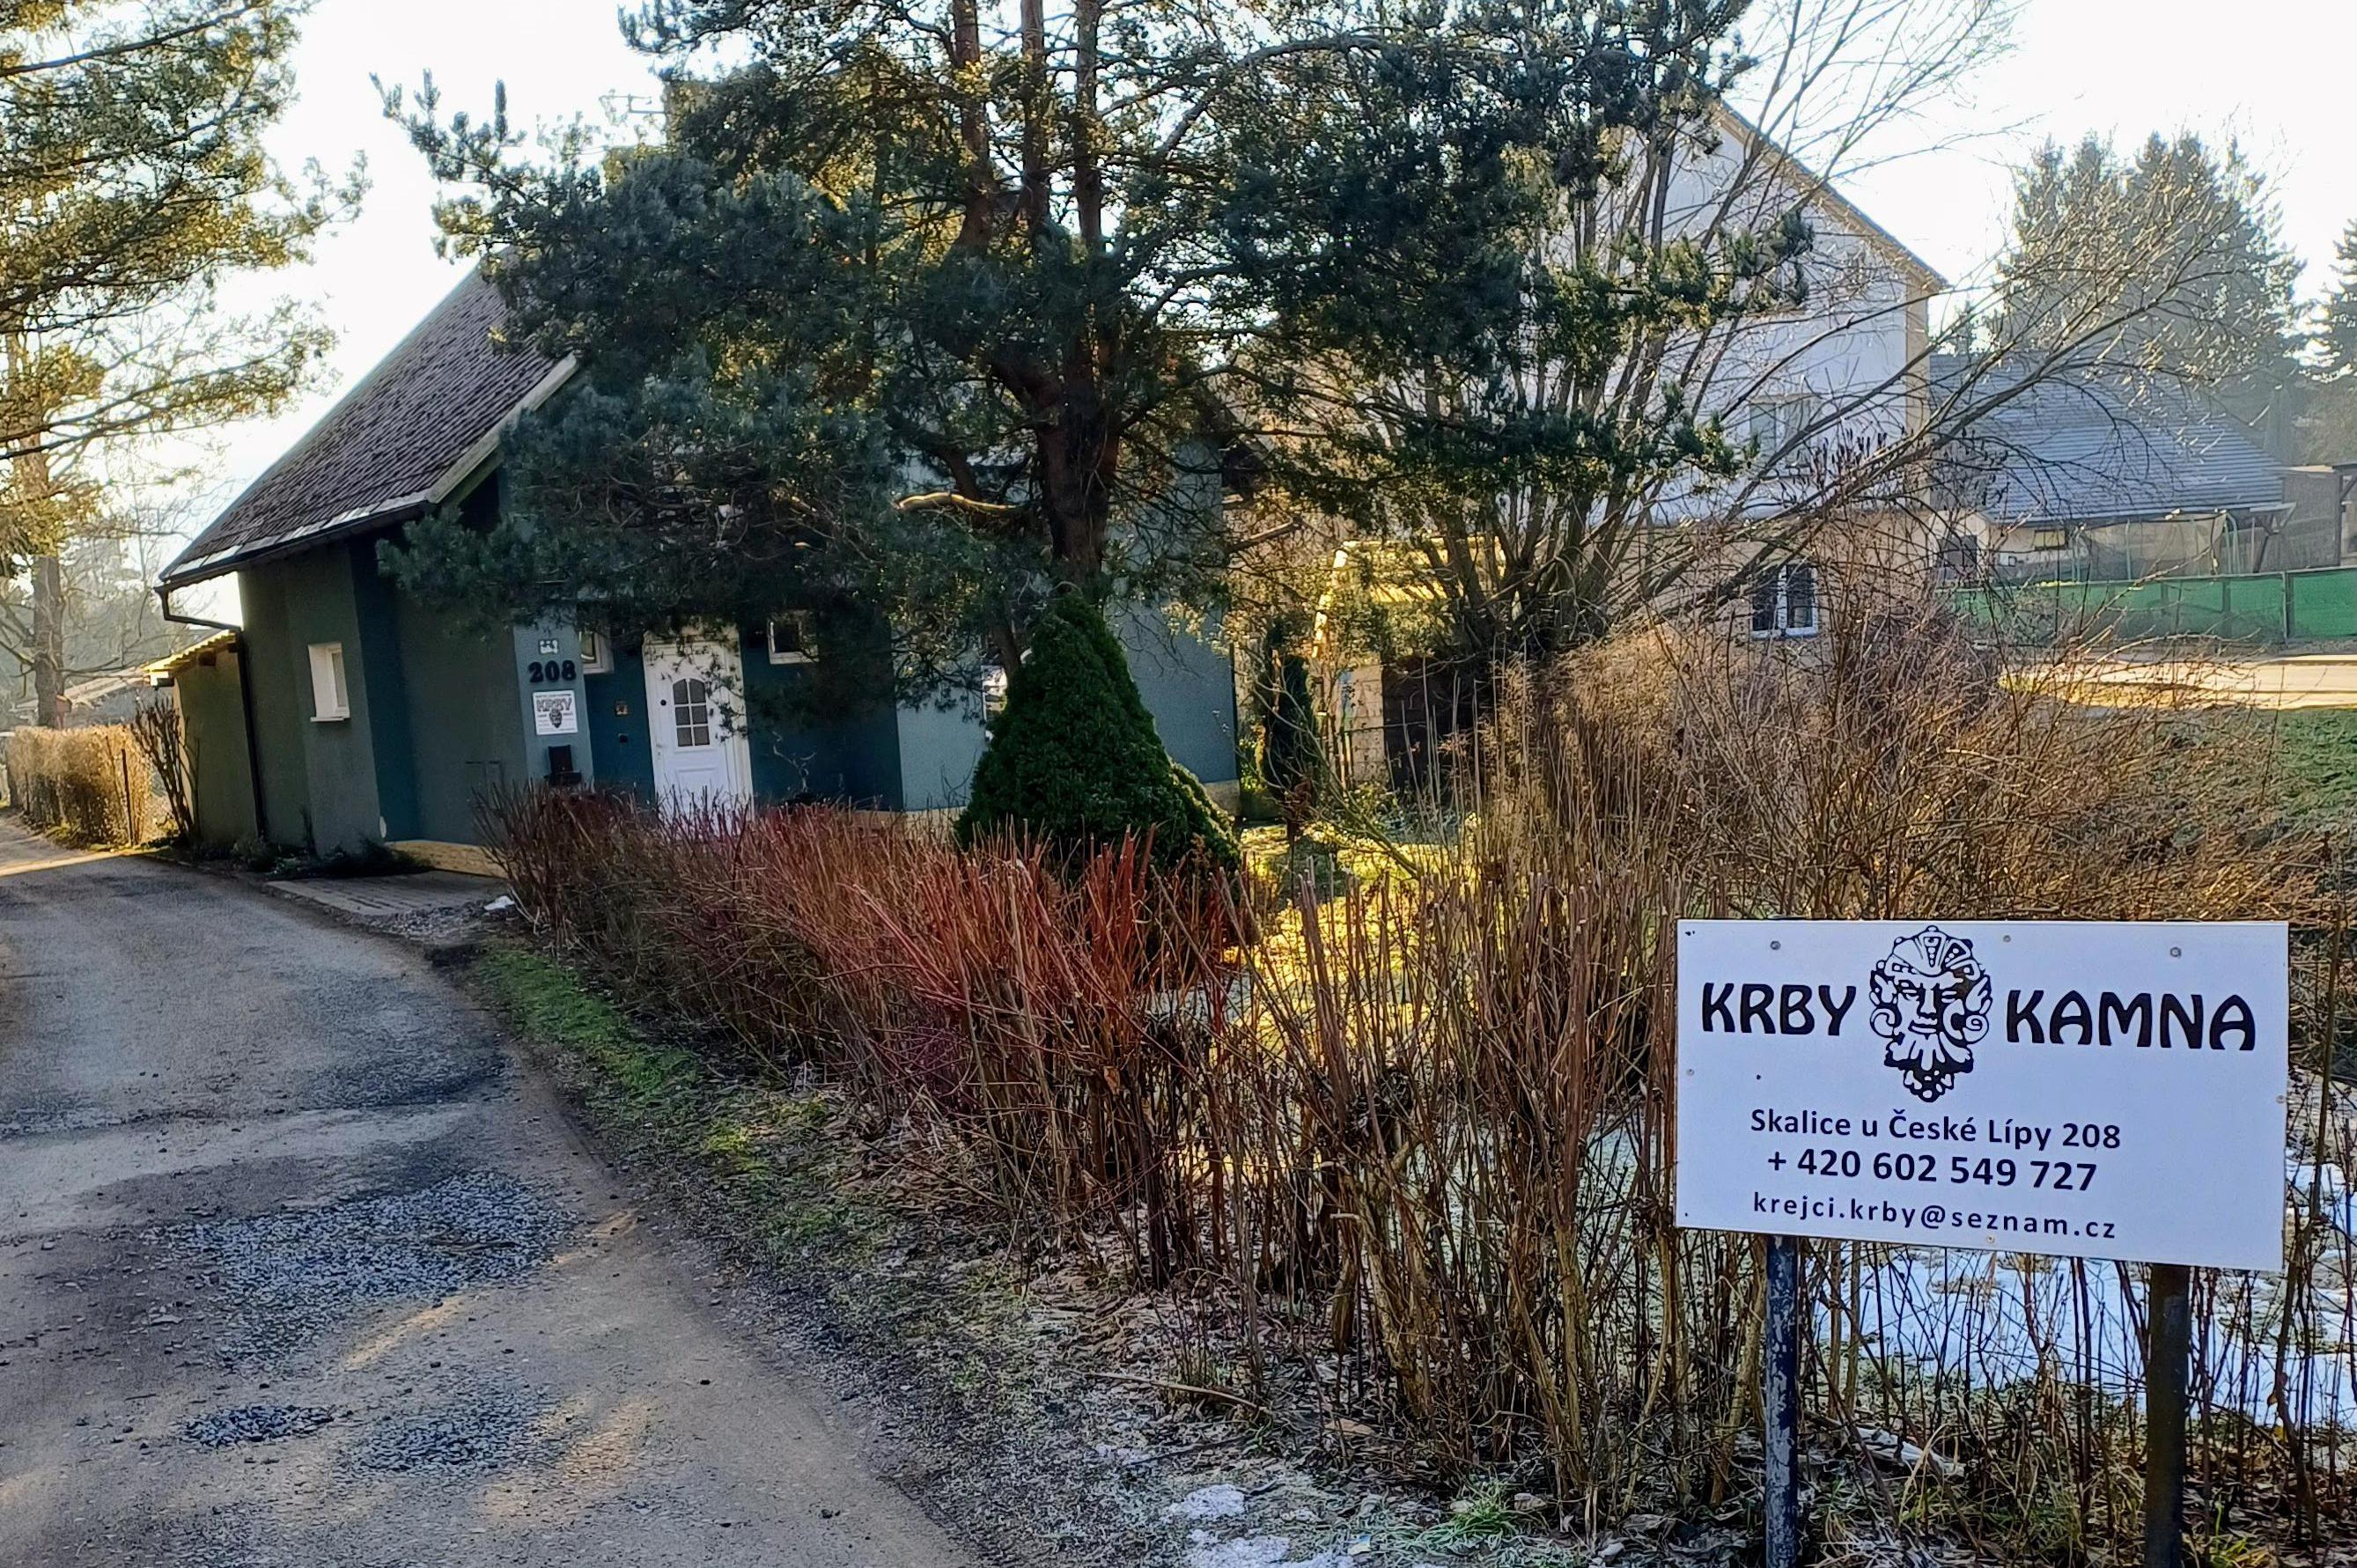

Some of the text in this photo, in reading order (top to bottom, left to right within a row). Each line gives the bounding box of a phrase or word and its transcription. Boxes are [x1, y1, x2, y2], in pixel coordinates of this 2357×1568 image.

[529, 659, 577, 683] 208
[1701, 982, 2257, 1051] KRBY KAMNA
[1749, 1108, 2122, 1152] Skalice u České Lípy 208
[1872, 1152, 1938, 1183] 602
[1949, 1156, 2017, 1188] 549
[2029, 1160, 2098, 1192] 727
[1753, 1191, 2117, 1240] krejci.krby@seznam.cz
